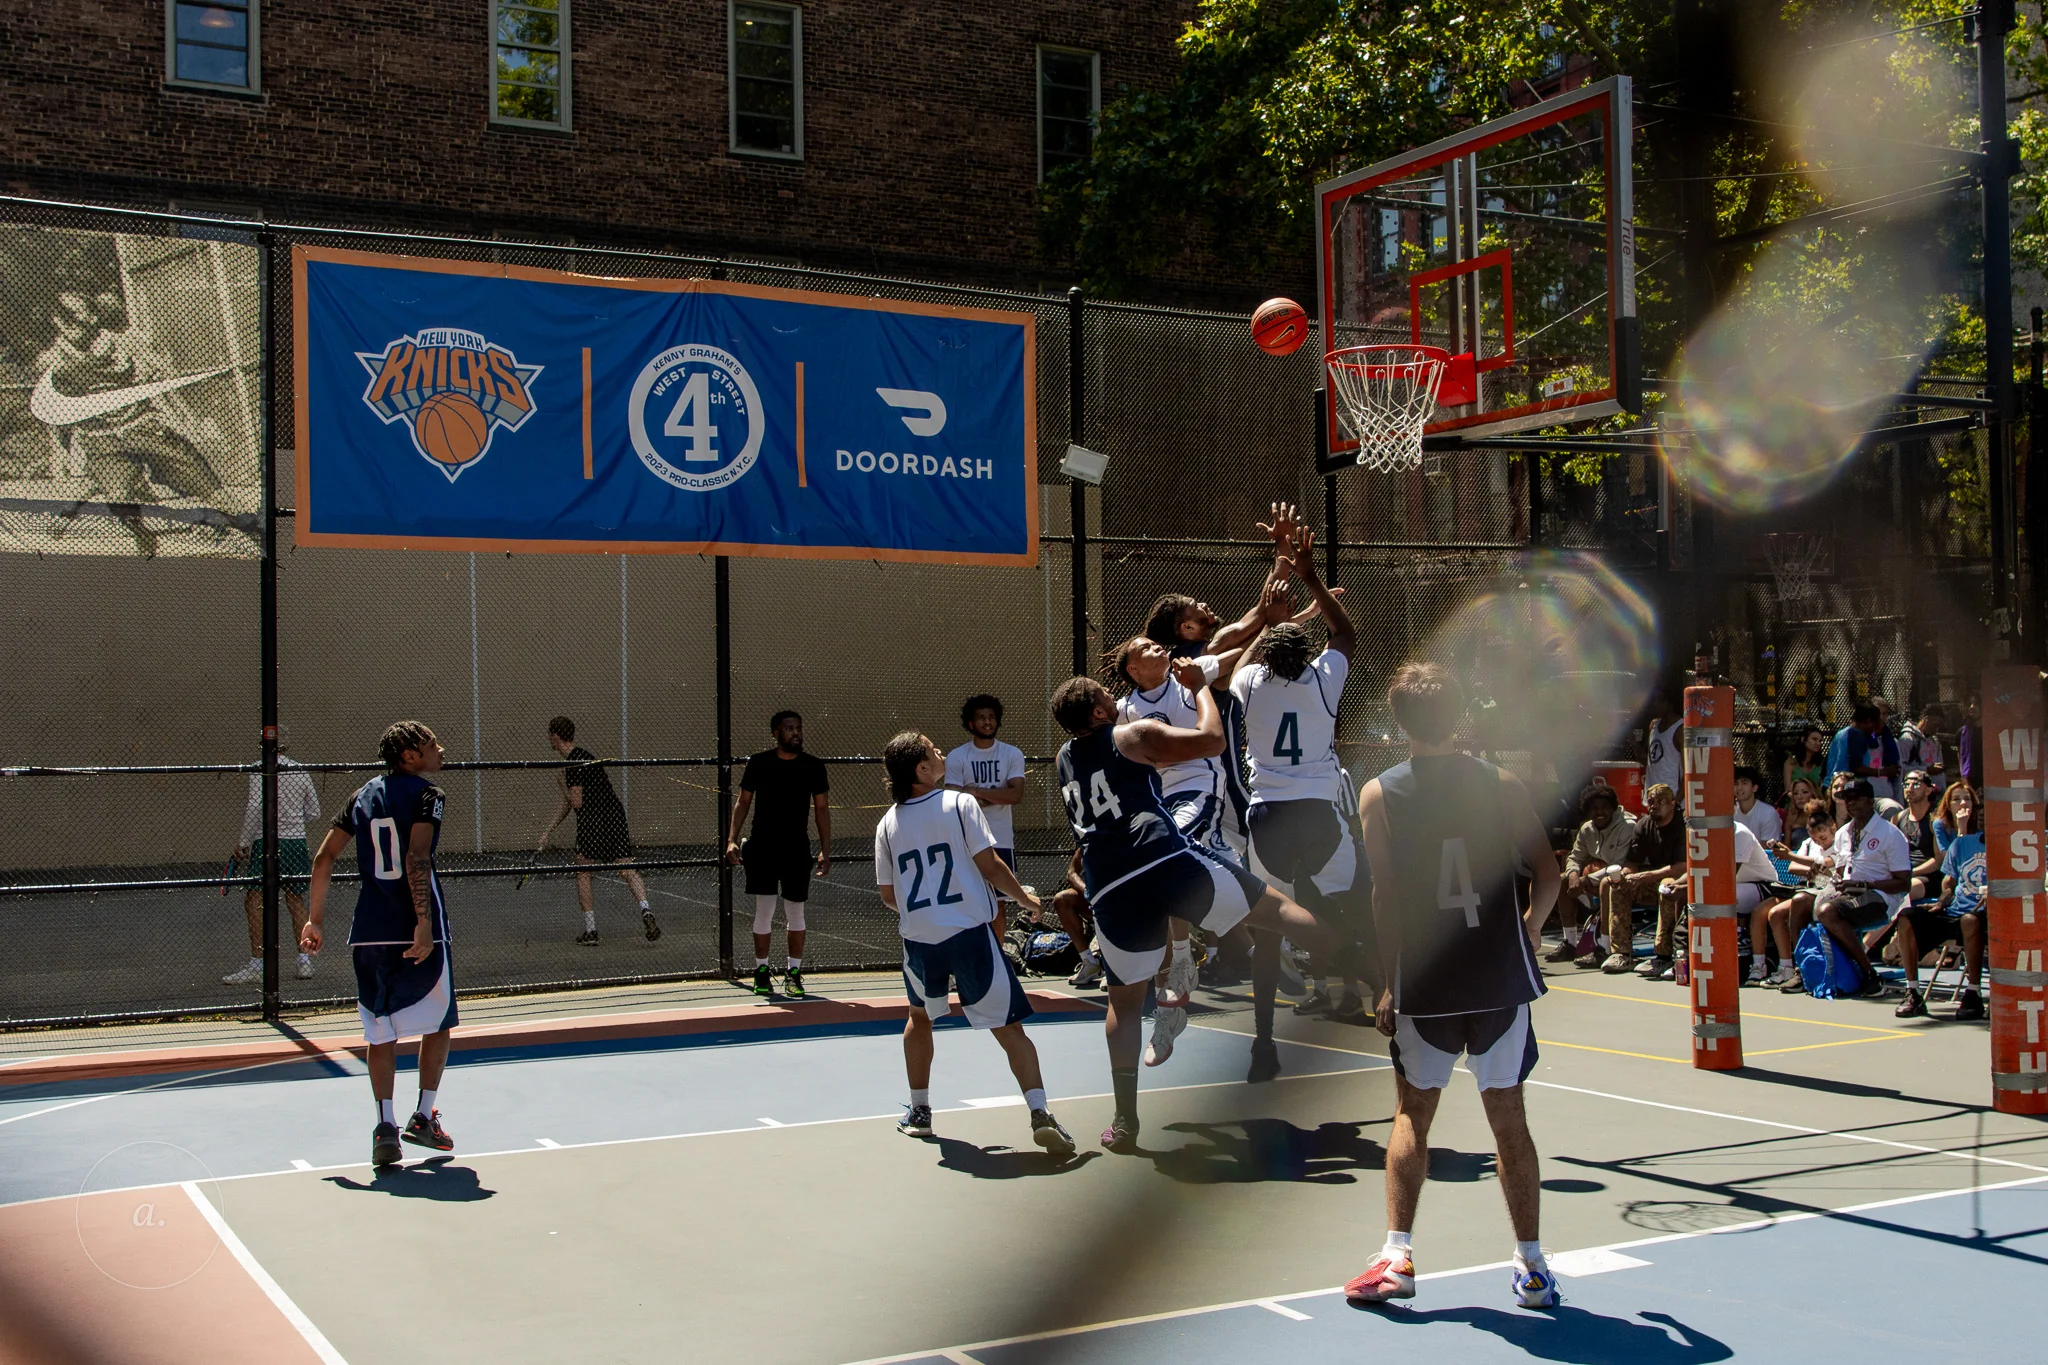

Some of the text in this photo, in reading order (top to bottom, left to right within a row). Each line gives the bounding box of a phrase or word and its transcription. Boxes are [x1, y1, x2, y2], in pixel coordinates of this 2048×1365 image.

[418, 331, 484, 350] NEW YORK
[653, 348, 742, 376] KENNY GRAHAM'S
[369, 342, 532, 414] KNICKS
[653, 367, 686, 397] WEST
[711, 370, 746, 416] STREET
[644, 453, 753, 489] 2023 PRO-CLASSIC N.Y.C.
[836, 450, 993, 480] DOORDASH
[1272, 712, 1303, 765] 4
[971, 760, 1000, 783] VOTE
[370, 817, 403, 880] 0
[1684, 747, 1711, 904] WEST
[898, 842, 964, 913] 22
[1437, 837, 1481, 927] 4
